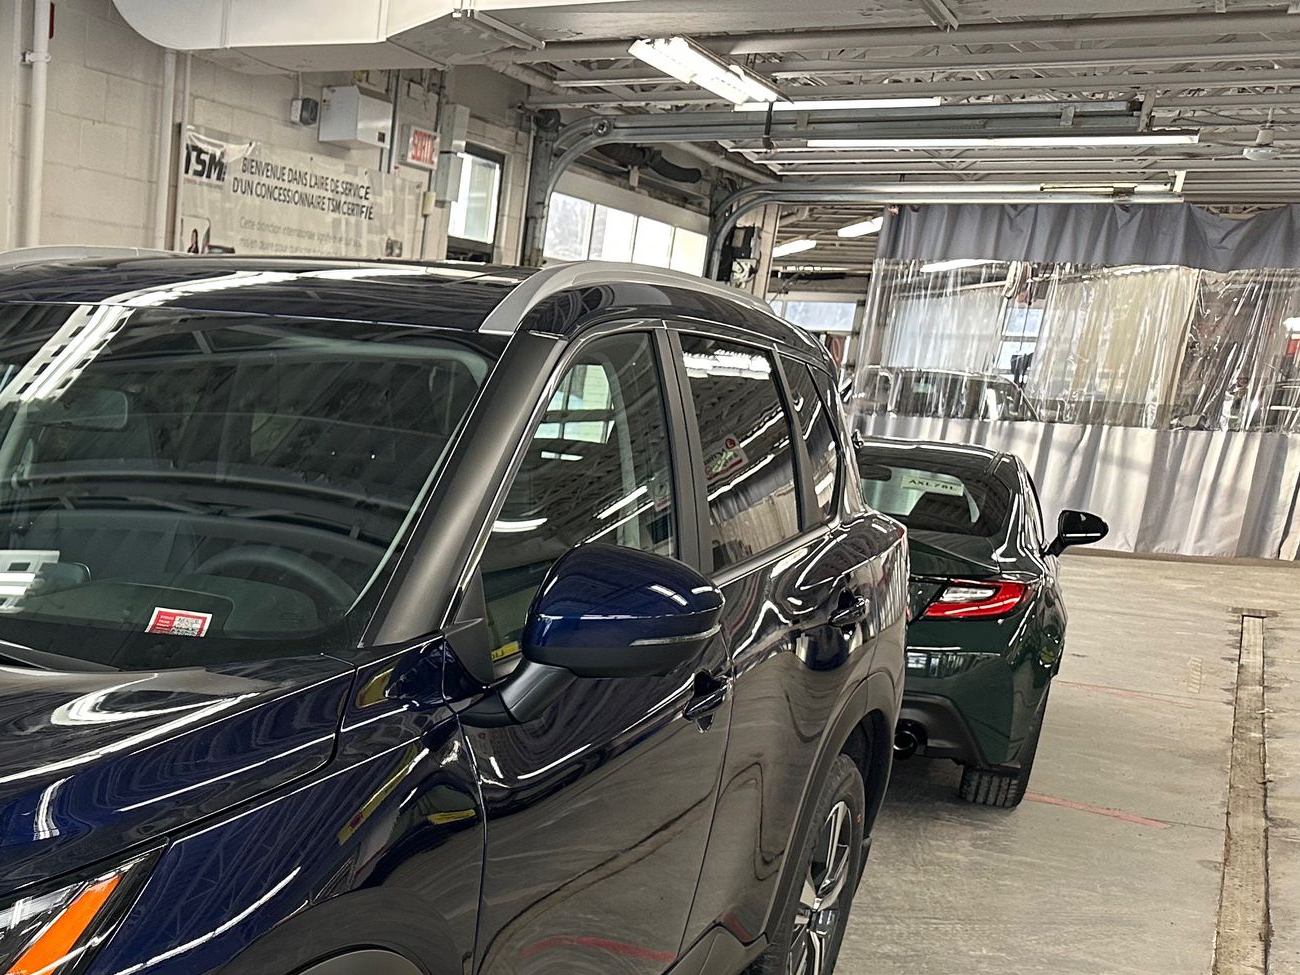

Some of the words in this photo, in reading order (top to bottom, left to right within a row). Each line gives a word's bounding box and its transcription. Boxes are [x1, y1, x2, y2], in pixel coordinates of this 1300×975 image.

[241, 156, 286, 182] BIENVENUE
[287, 167, 308, 187] DANS
[330, 178, 340, 194] DE
[340, 181, 371, 201] SERVICE
[255, 181, 327, 212] CONCESSIONNAIRE
